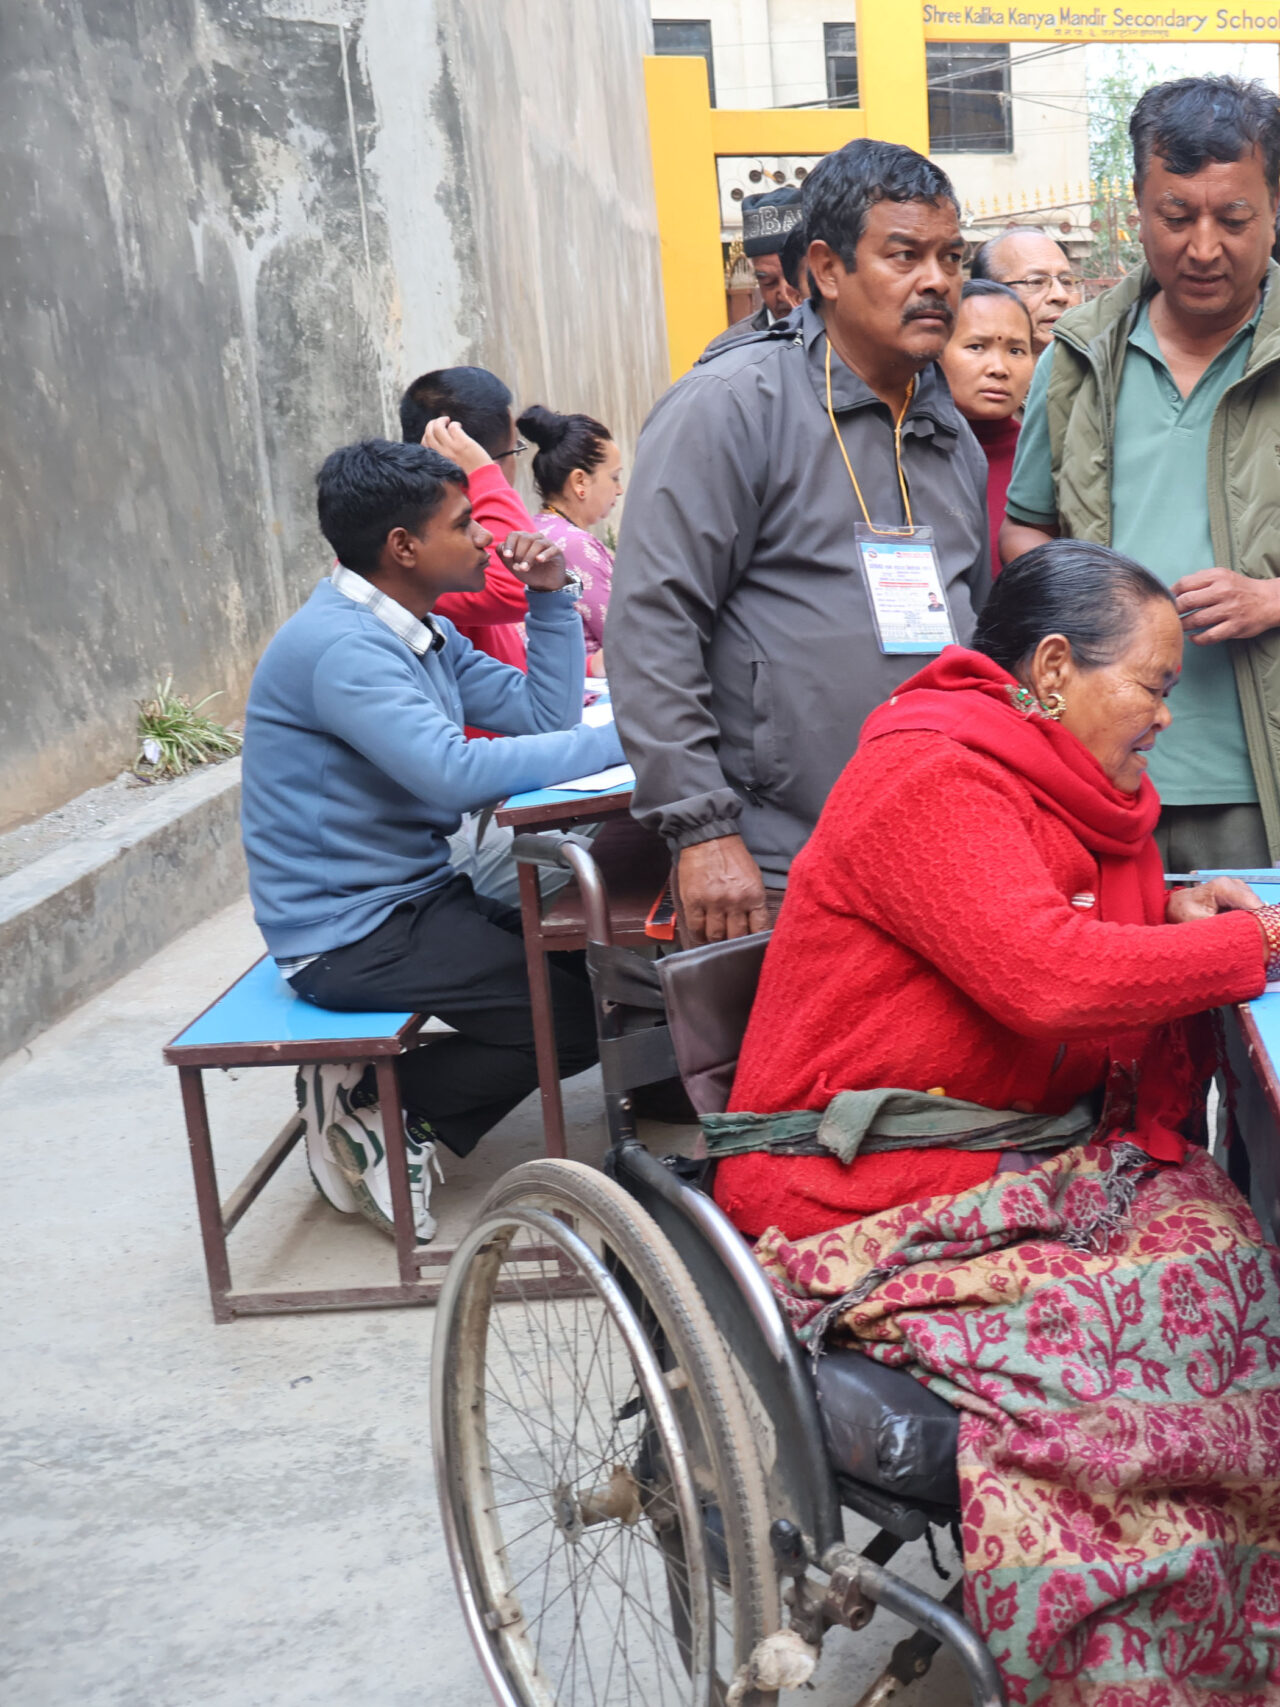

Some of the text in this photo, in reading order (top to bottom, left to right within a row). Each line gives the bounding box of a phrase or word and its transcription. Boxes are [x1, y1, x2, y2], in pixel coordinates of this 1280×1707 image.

[922, 5, 962, 24] Shree
[965, 6, 1005, 25] Kalika
[1008, 7, 1056, 30] Kanya
[1060, 7, 1107, 27] Mandir
[1113, 8, 1208, 33] Secondary
